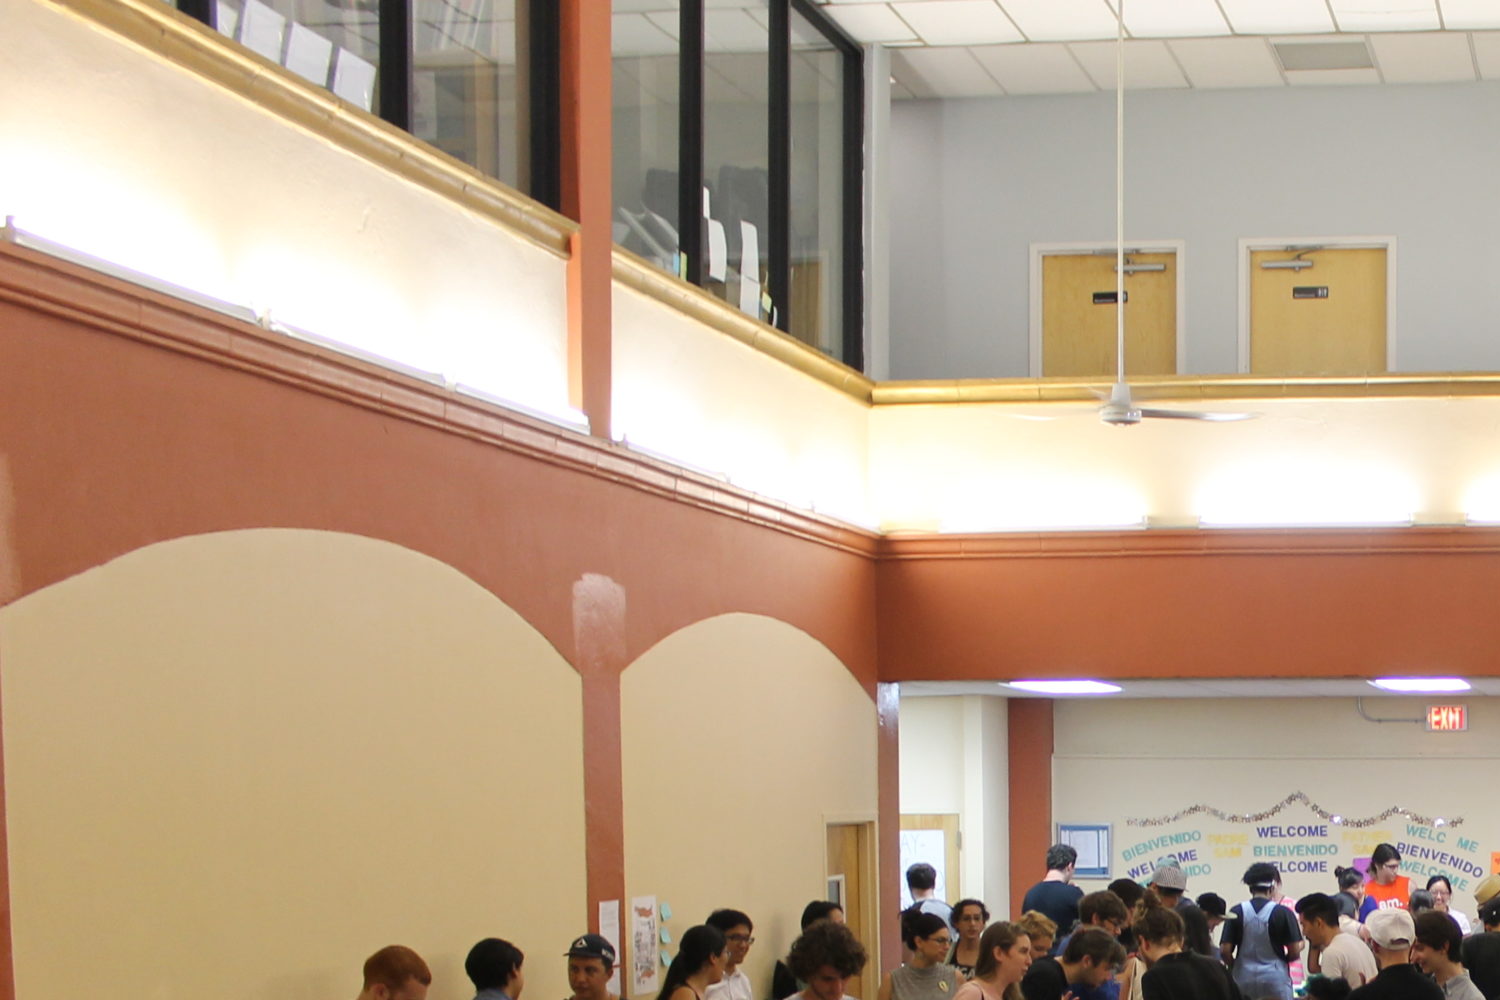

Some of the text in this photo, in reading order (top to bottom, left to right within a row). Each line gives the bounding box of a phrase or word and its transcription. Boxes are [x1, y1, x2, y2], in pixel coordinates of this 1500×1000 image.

[1431, 706, 1462, 730] EXIT
[1256, 825, 1328, 838] WELCOME
[1122, 830, 1202, 862] BIENVENIDO
[1253, 844, 1338, 857] BIENVENIDO
[1272, 860, 1328, 873] ELCOME
[1396, 842, 1484, 878] BIENVENIDO
